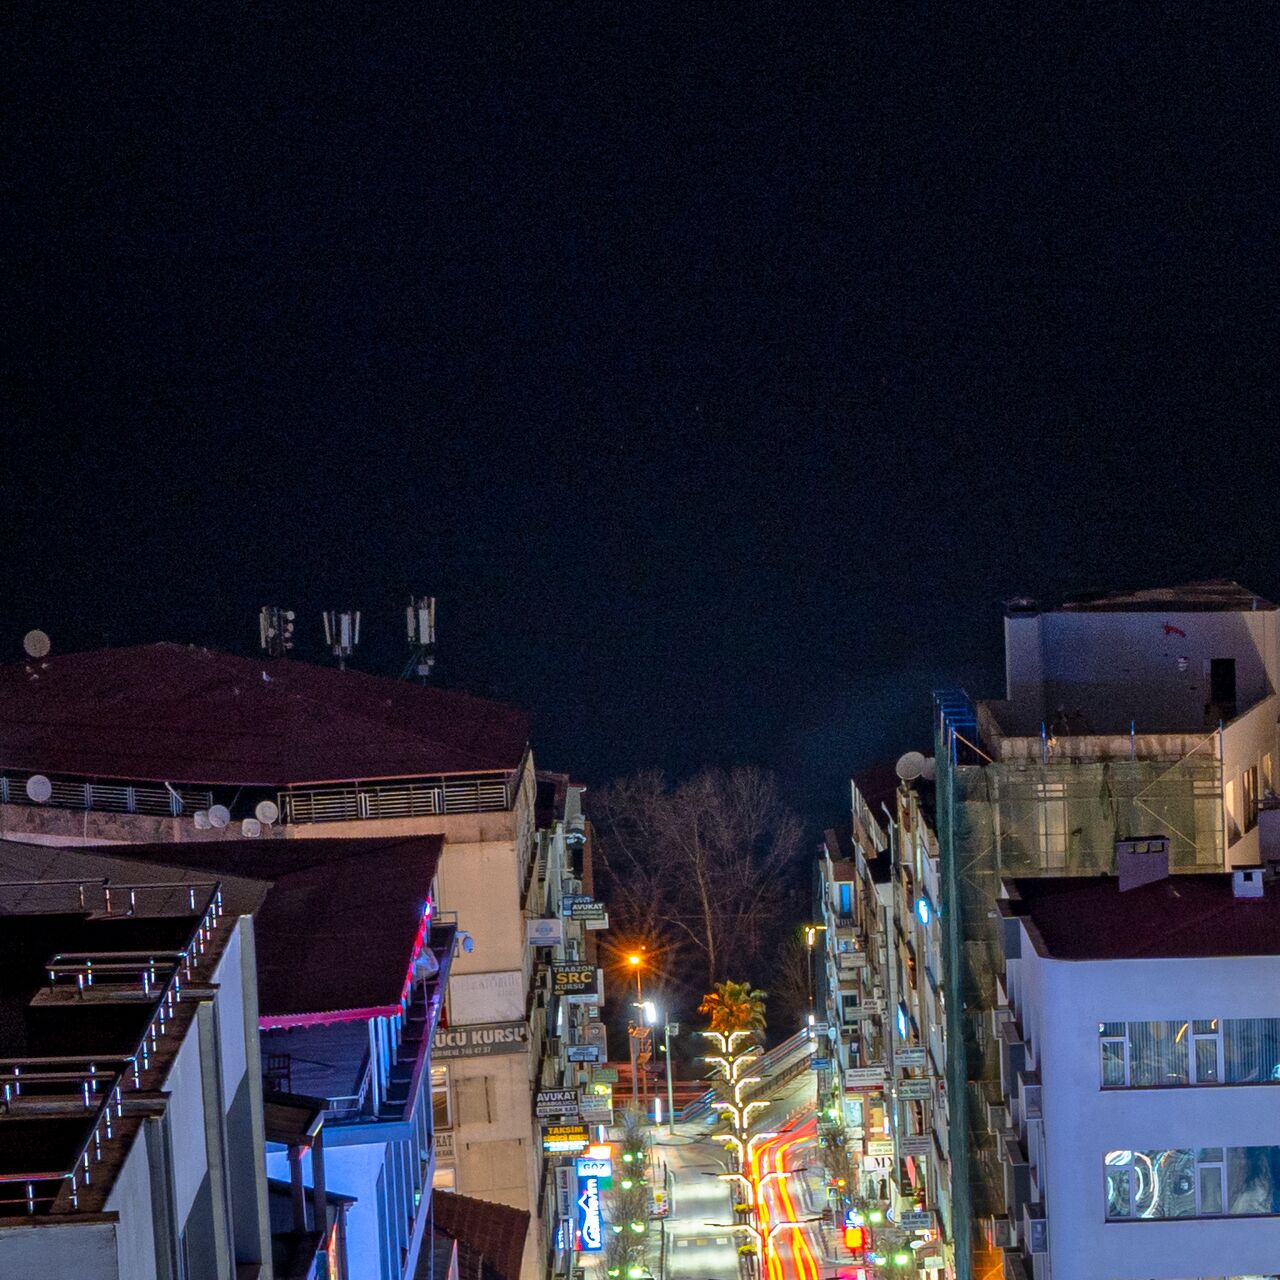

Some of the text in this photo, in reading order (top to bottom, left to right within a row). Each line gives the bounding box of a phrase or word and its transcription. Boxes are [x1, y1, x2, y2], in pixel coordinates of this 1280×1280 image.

[556, 972, 592, 984] SRC
[471, 1027, 525, 1045] KURSU
[537, 1091, 576, 1101] AVUKAT
